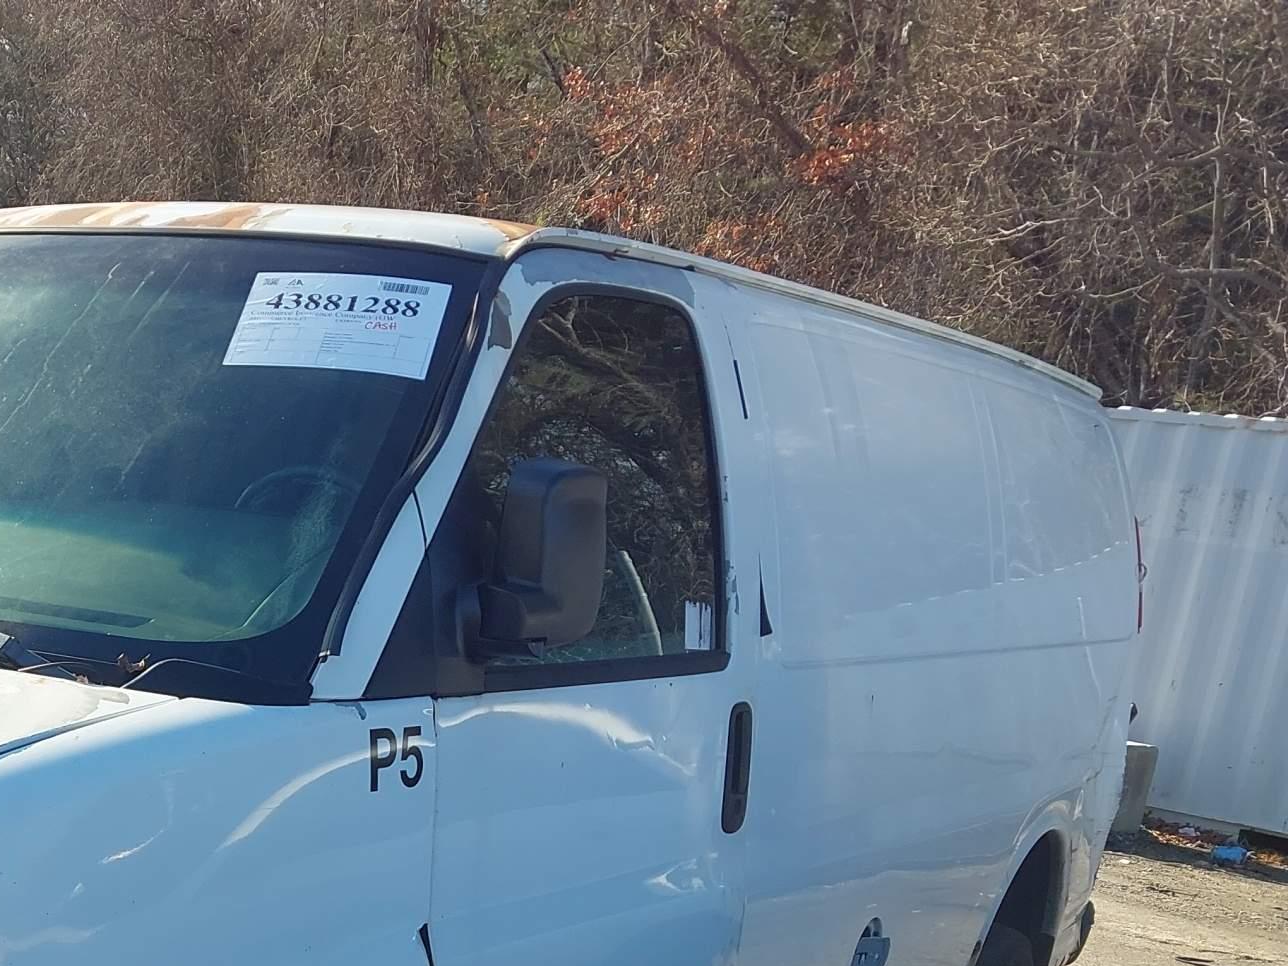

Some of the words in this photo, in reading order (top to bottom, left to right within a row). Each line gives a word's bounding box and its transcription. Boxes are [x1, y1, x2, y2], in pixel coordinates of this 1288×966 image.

[265, 291, 421, 319] 43881288
[364, 321, 397, 331] CASH
[369, 725, 424, 793] P5
